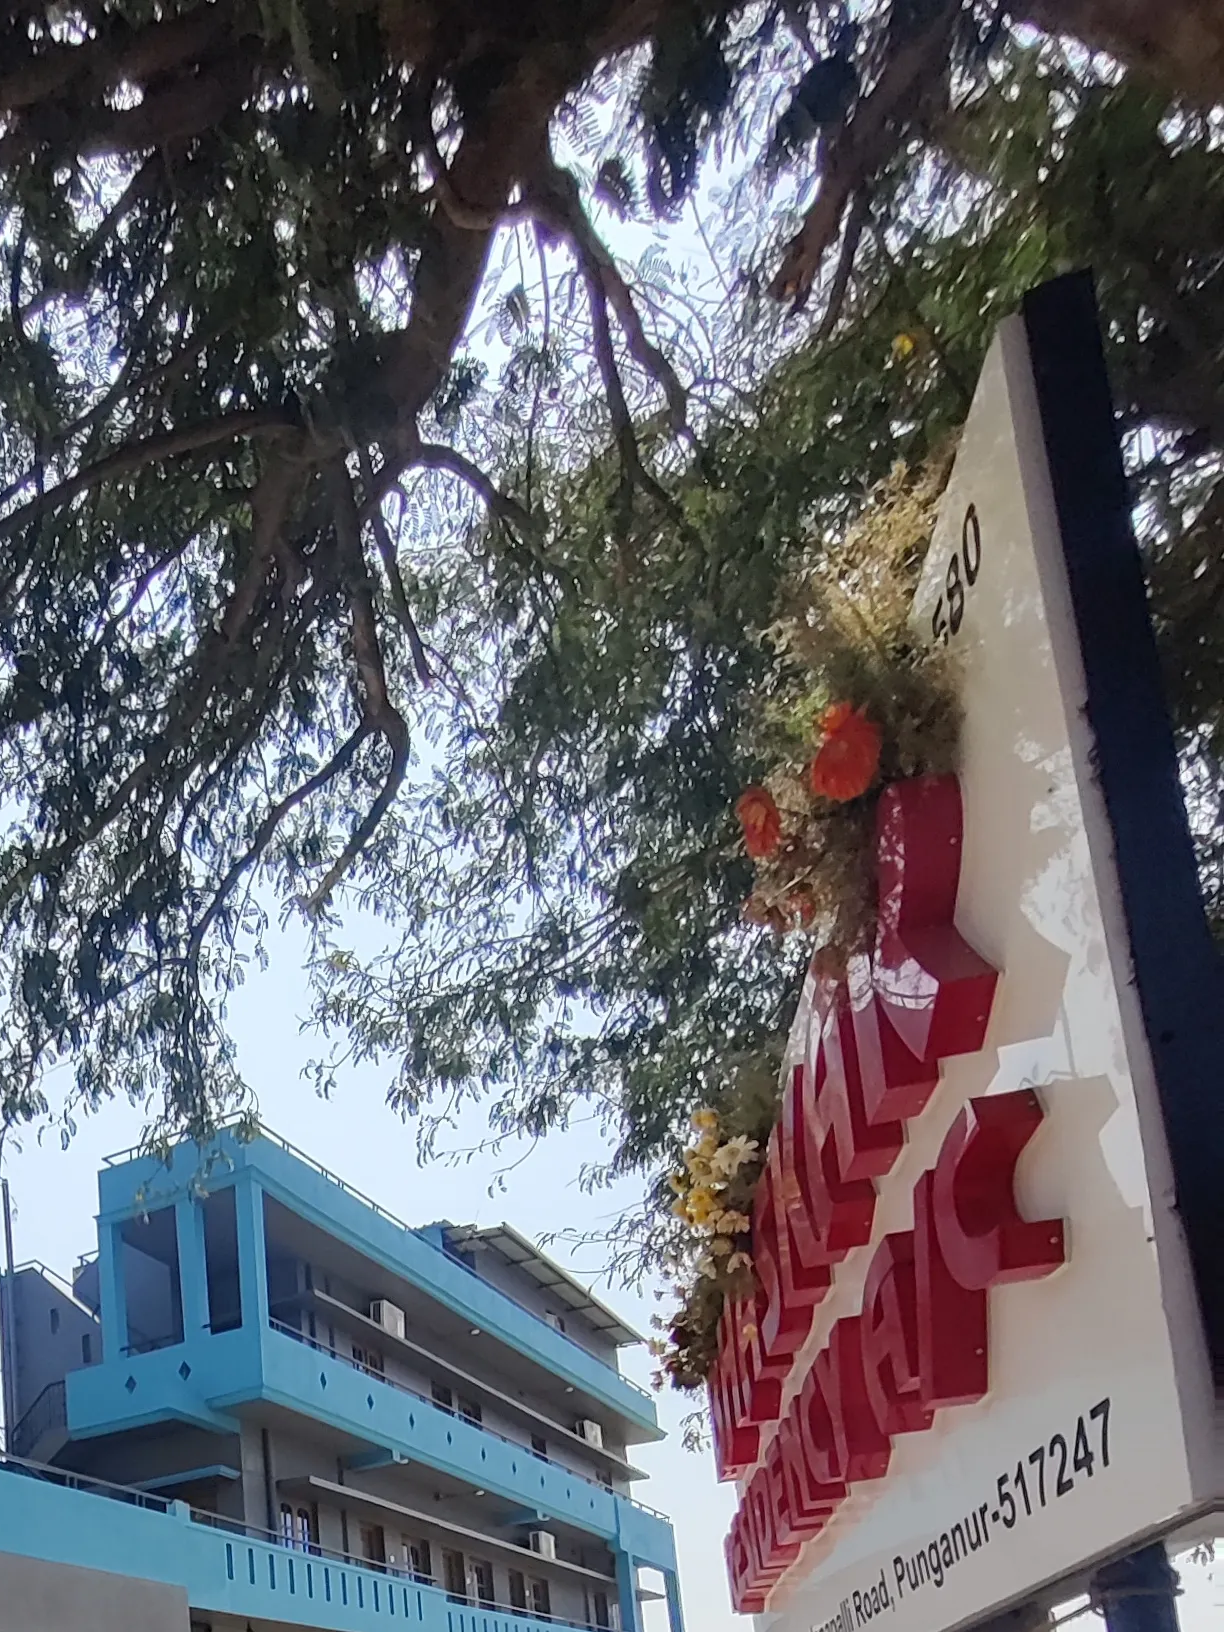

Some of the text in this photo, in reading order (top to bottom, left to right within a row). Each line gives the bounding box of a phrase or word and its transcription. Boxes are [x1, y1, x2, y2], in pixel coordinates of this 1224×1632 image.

[863, 1088, 1066, 1436] A/C
[851, 1568, 895, 1629] Road,
[892, 1396, 1111, 1599] Punganur-517247
